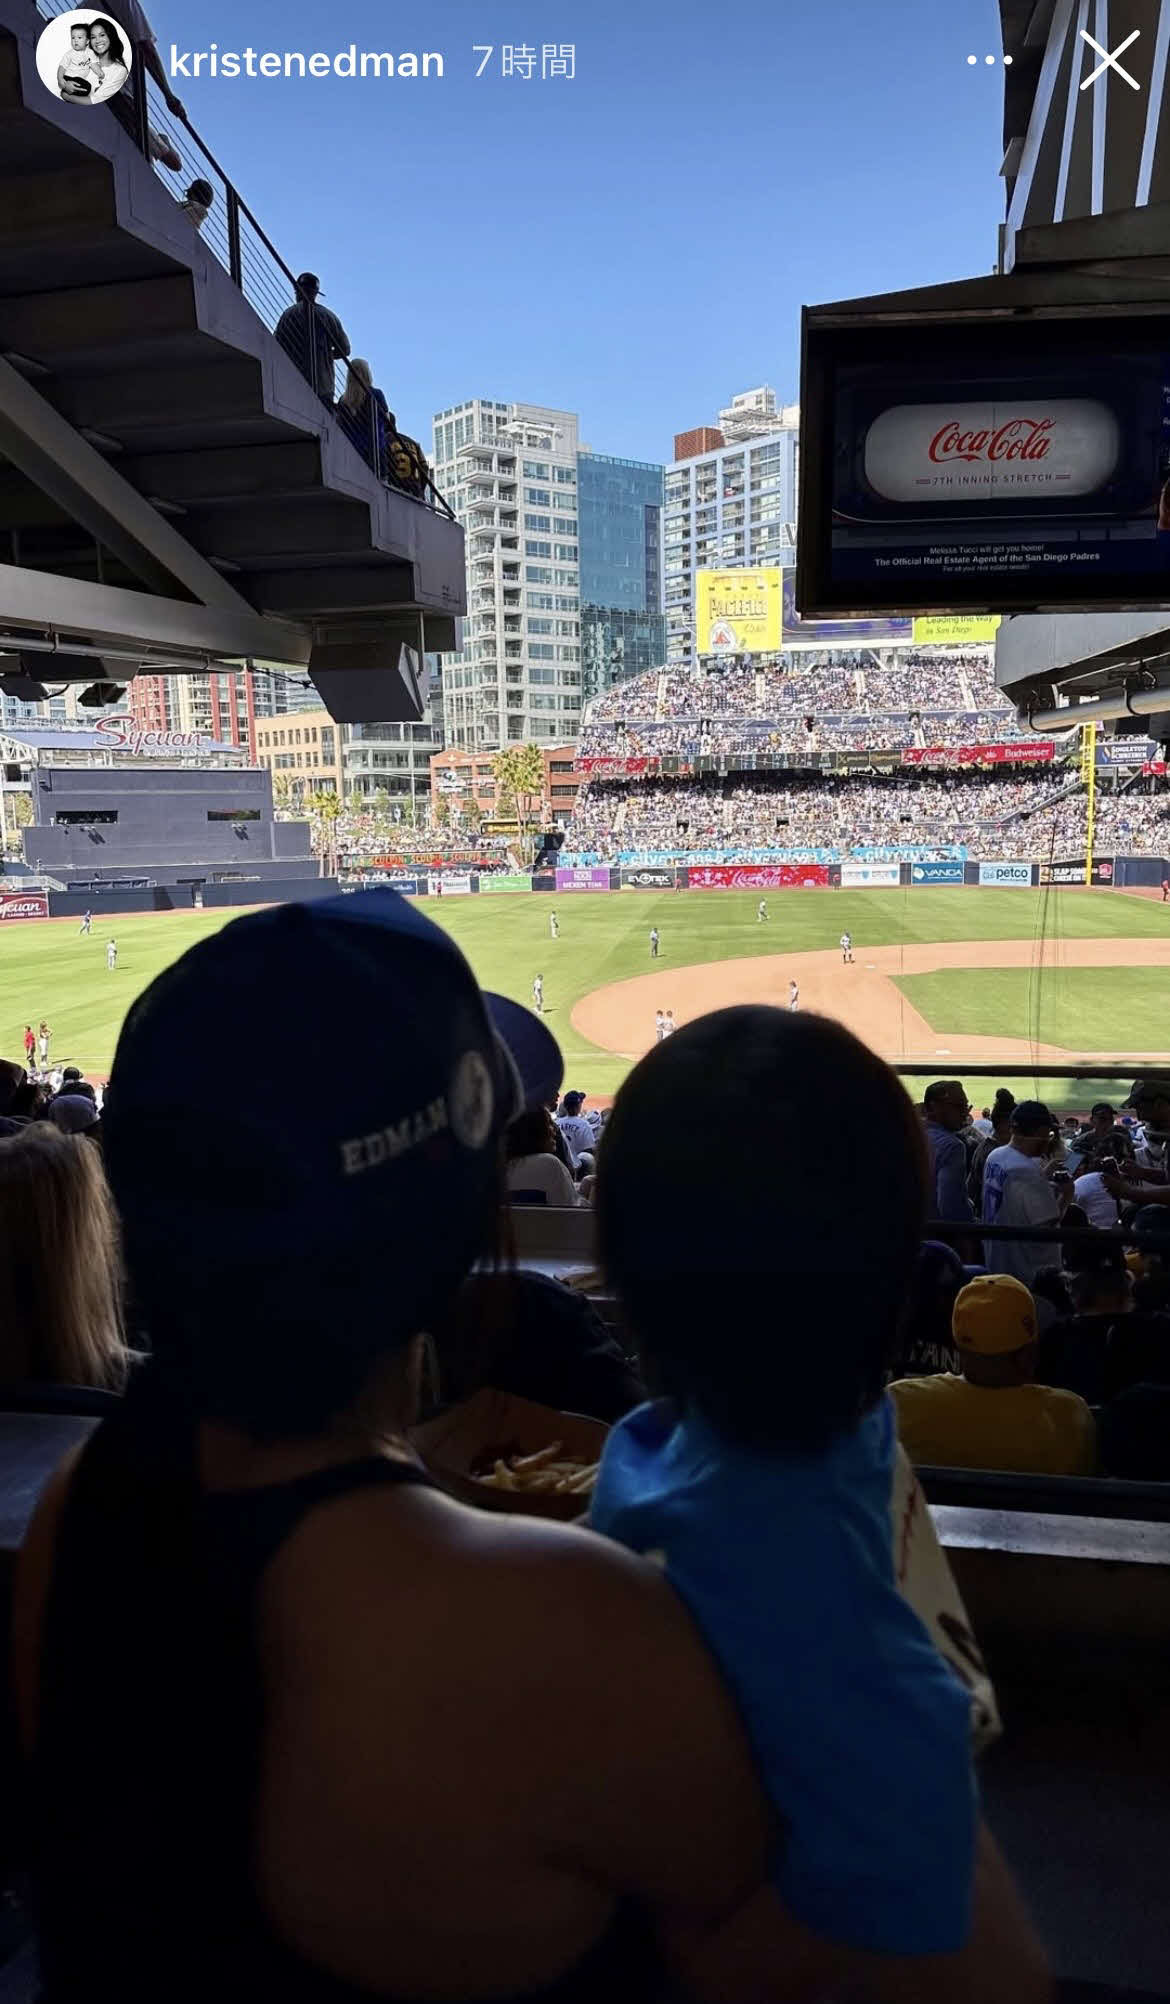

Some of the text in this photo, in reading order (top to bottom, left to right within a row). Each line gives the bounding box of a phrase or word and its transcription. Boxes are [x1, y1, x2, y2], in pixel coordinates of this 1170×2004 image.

[928, 417, 1057, 464] Coca-Cola
[932, 473, 1052, 487] 7TH INNING STRETCH
[1006, 544, 1020, 554] you
[875, 551, 1101, 567] The Official Real Estate Agent of the San Diego Padres
[926, 614, 993, 625] Leading the Way
[95, 714, 203, 757] Sycuan
[1003, 747, 1051, 759] Budweiser
[995, 866, 1029, 880] petco
[0, 897, 41, 919] ycuan
[340, 1095, 449, 1175] EDMAN
